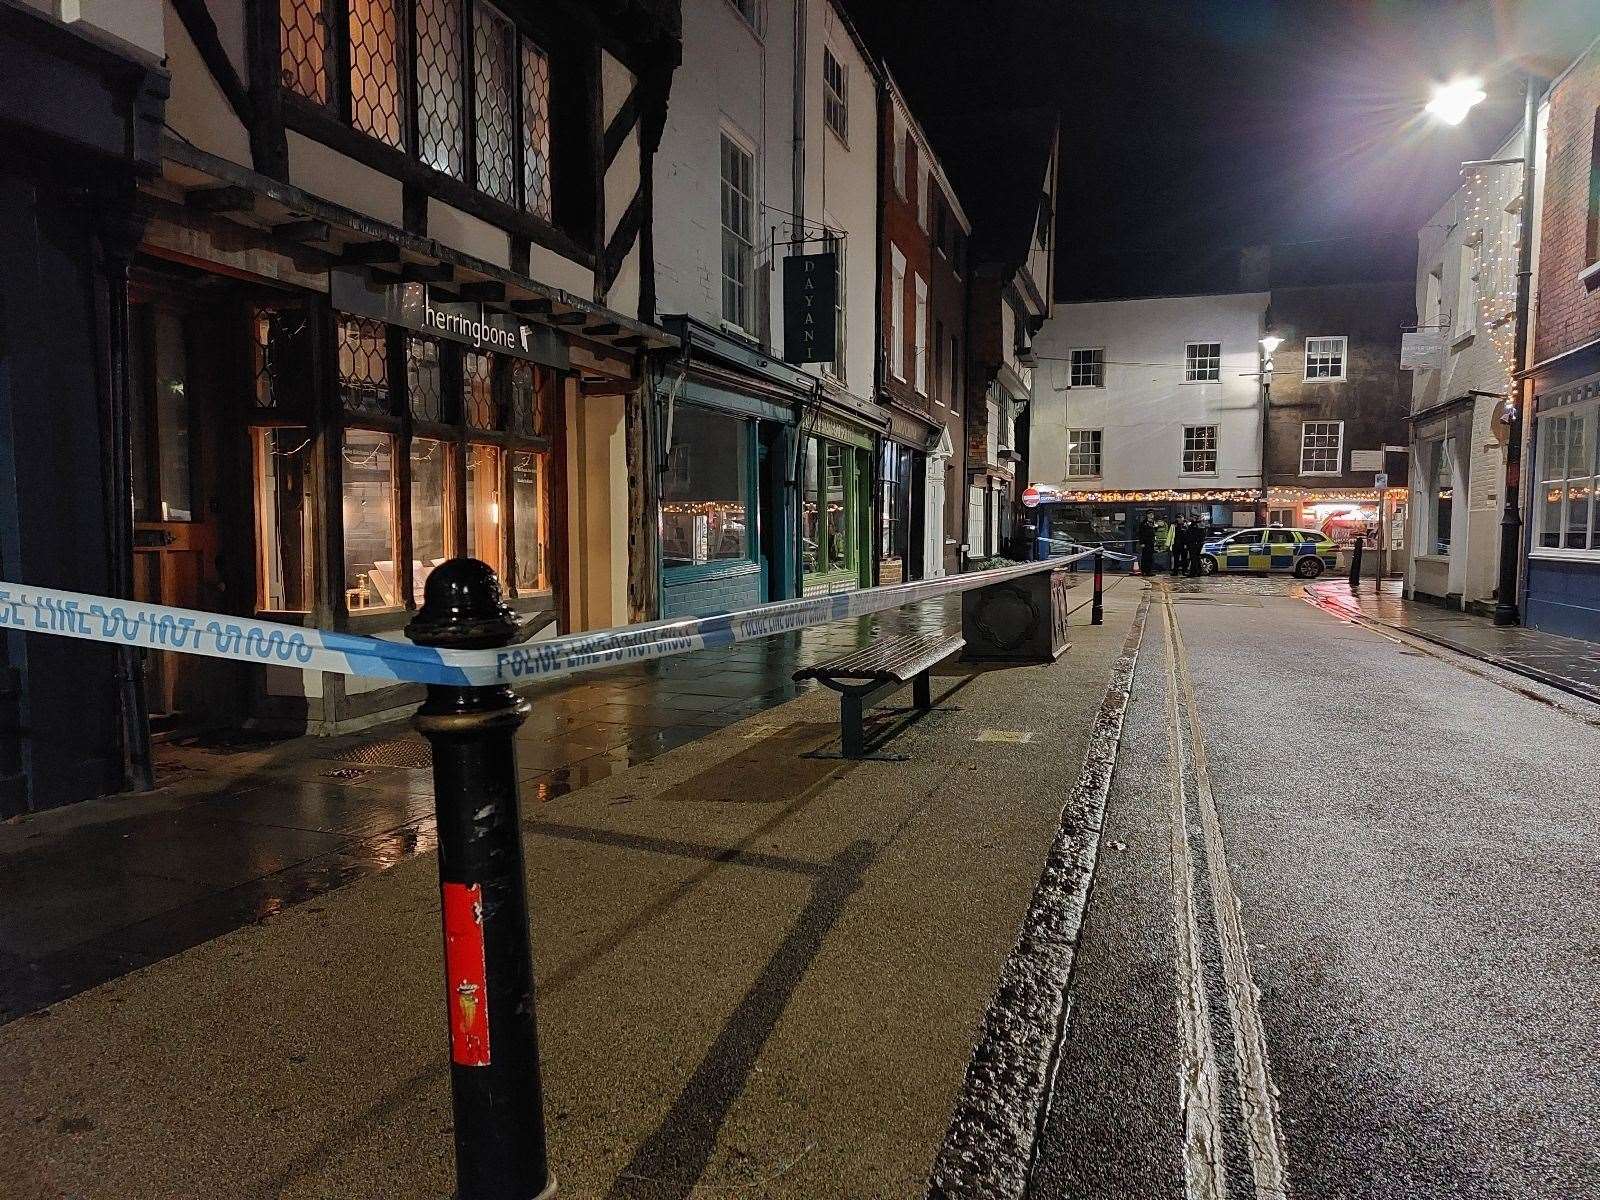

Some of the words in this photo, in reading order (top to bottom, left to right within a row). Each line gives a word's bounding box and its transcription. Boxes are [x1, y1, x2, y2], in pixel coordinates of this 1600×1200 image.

[425, 282, 516, 348] herringbone
[804, 260, 816, 359] DAYANI
[496, 645, 561, 678] POLICE
